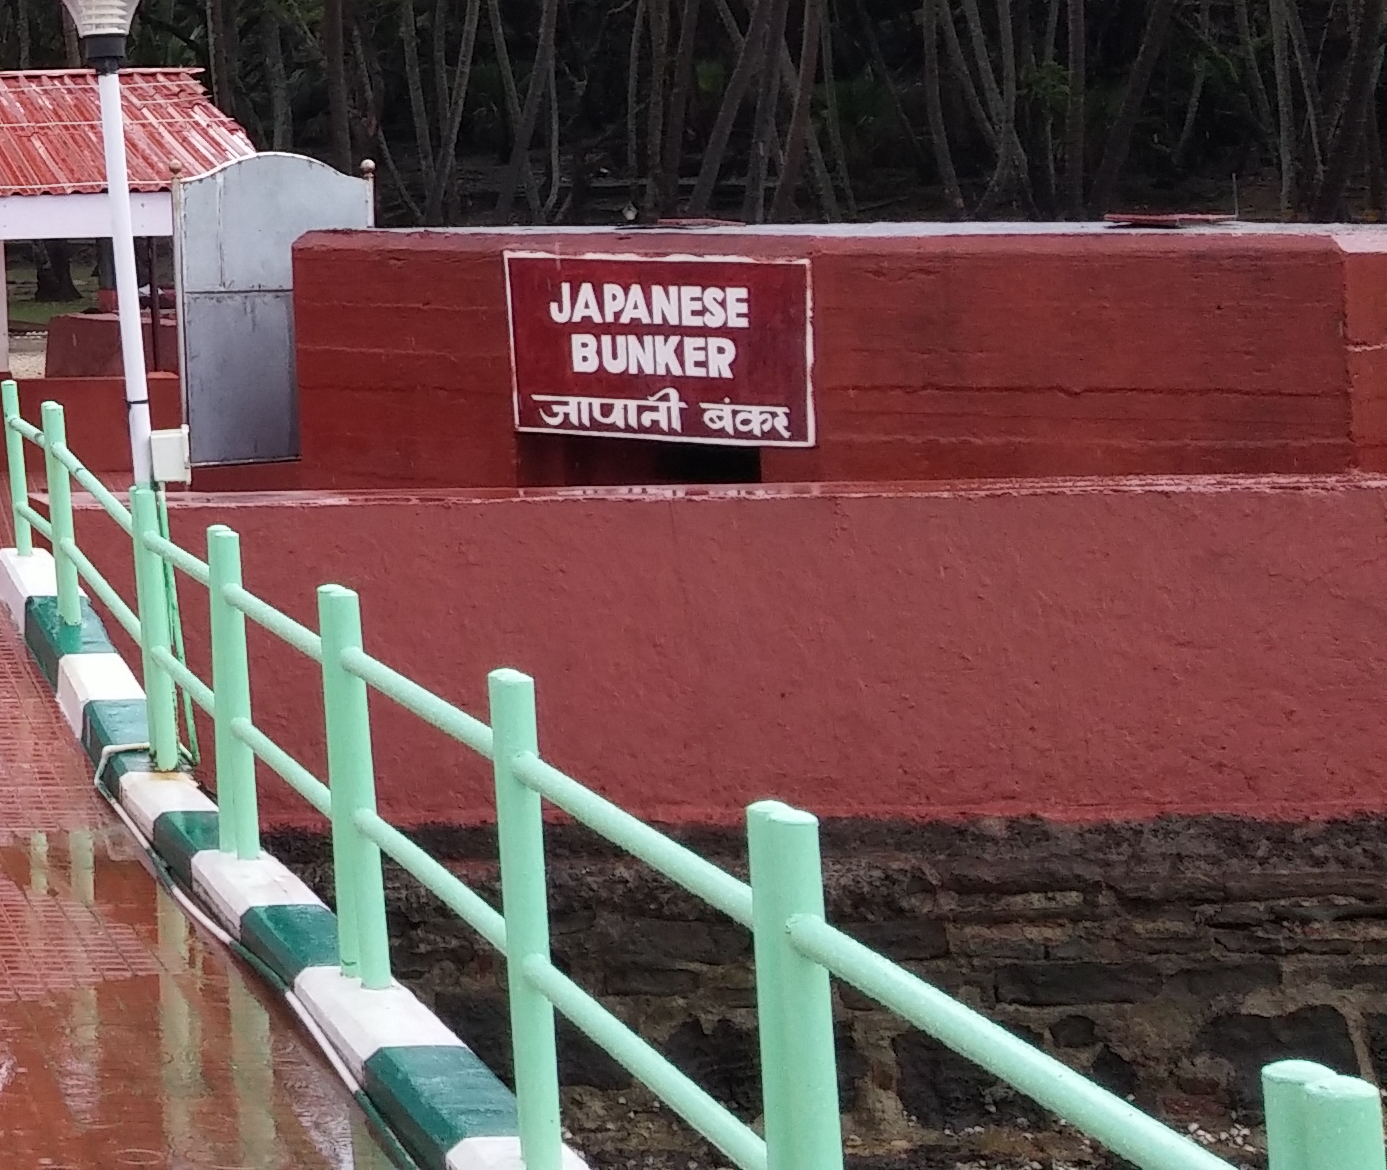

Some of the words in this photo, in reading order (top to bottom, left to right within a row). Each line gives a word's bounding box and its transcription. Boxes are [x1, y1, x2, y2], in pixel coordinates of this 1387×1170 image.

[549, 282, 750, 328] JAPANESE
[571, 333, 737, 379] BUNKER
[530, 387, 689, 433] जापानी
[699, 396, 792, 439] बंकर
